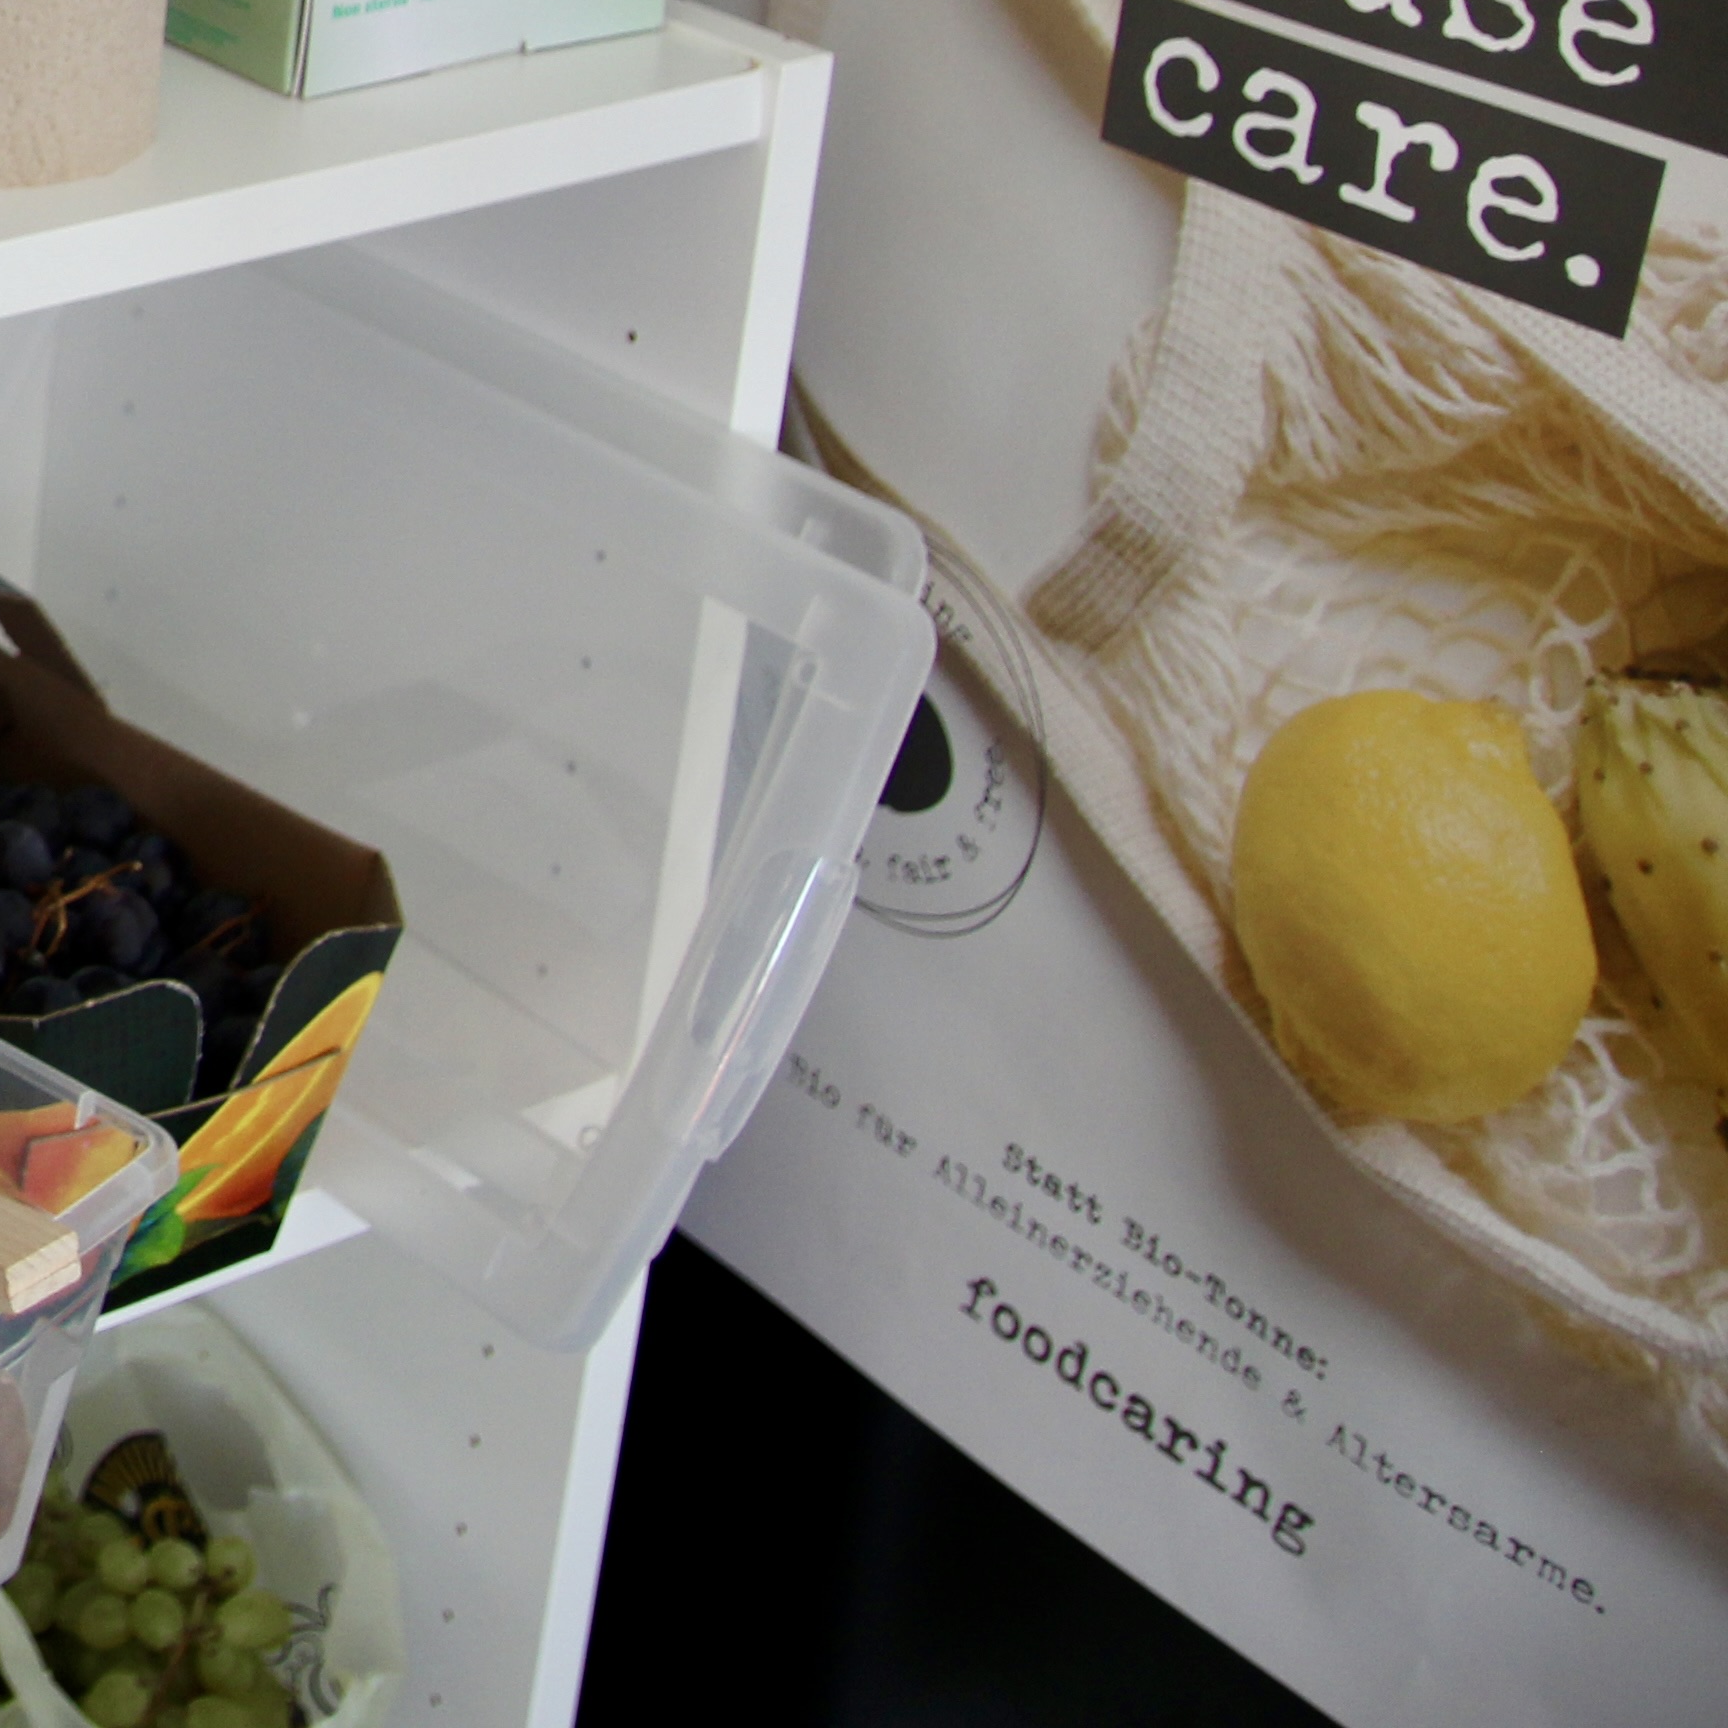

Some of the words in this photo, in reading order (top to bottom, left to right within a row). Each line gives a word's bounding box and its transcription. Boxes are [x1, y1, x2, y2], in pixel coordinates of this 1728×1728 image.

[1141, 36, 1601, 288] care.
[855, 1102, 919, 1158] für
[932, 1152, 1263, 1391] Alleinerziehende
[1280, 1388, 1307, 1425] &
[1325, 1422, 1608, 1617] Altersarme.
[1002, 1141, 1104, 1226] Statt
[1120, 1215, 1330, 1380] Bio-Tonne:
[958, 1274, 1317, 1559] foodcaring
